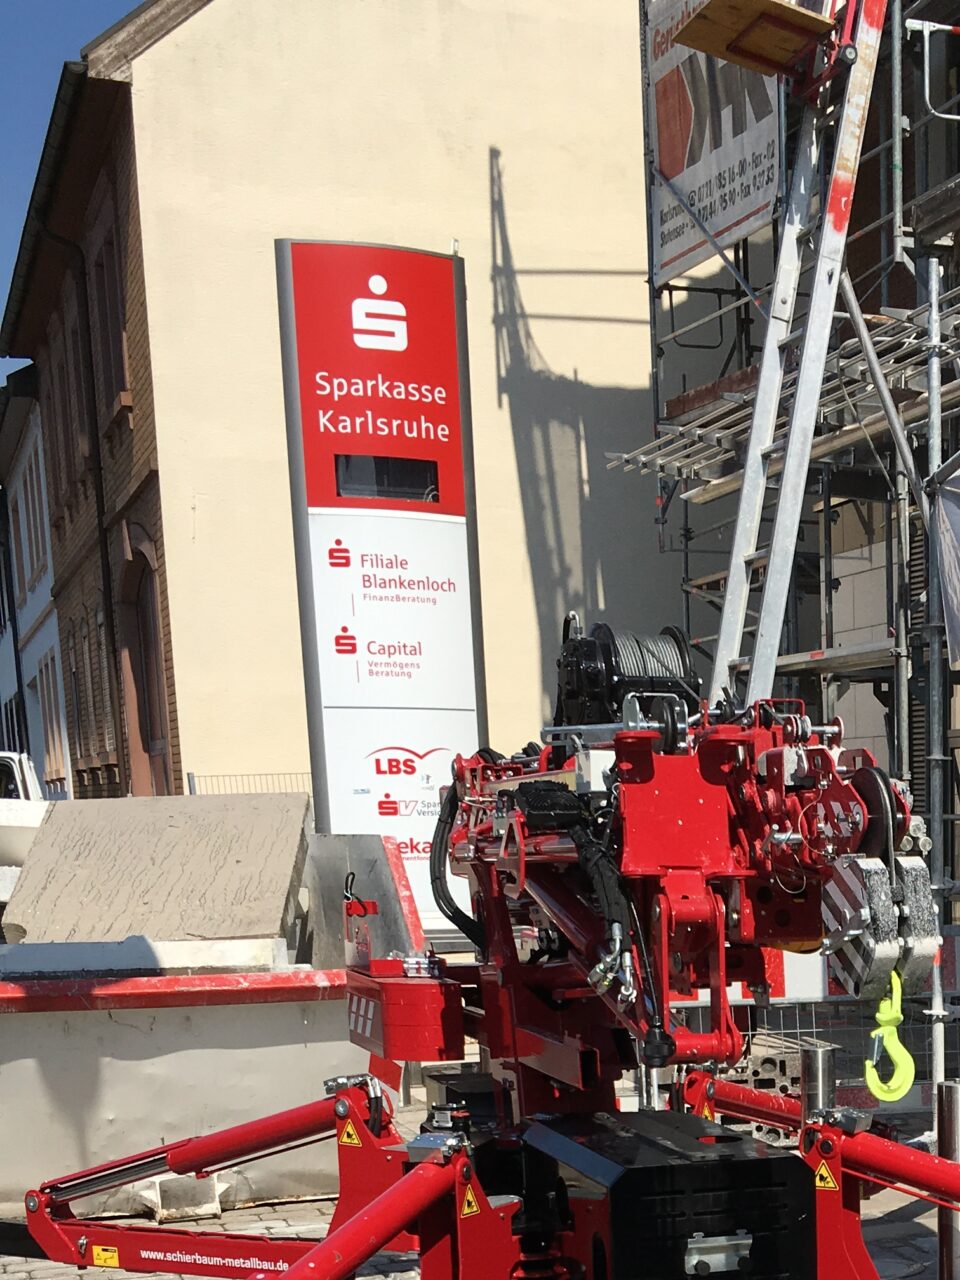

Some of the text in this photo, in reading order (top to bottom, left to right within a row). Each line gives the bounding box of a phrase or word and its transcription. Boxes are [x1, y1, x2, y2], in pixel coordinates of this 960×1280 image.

[315, 371, 447, 405] Sparkasse
[318, 409, 450, 442] Karlsruhe
[360, 553, 409, 570] Filiale
[361, 574, 457, 593] Blankenloch
[363, 593, 437, 606] FinanzBeratung
[366, 641, 423, 659] Capital
[367, 660, 421, 670] Vermögens
[368, 668, 412, 679] Beratung
[375, 758, 417, 776] LBS
[421, 800, 441, 809] Spar
[139, 1249, 289, 1272] www.schierbaum-metallbau.de
